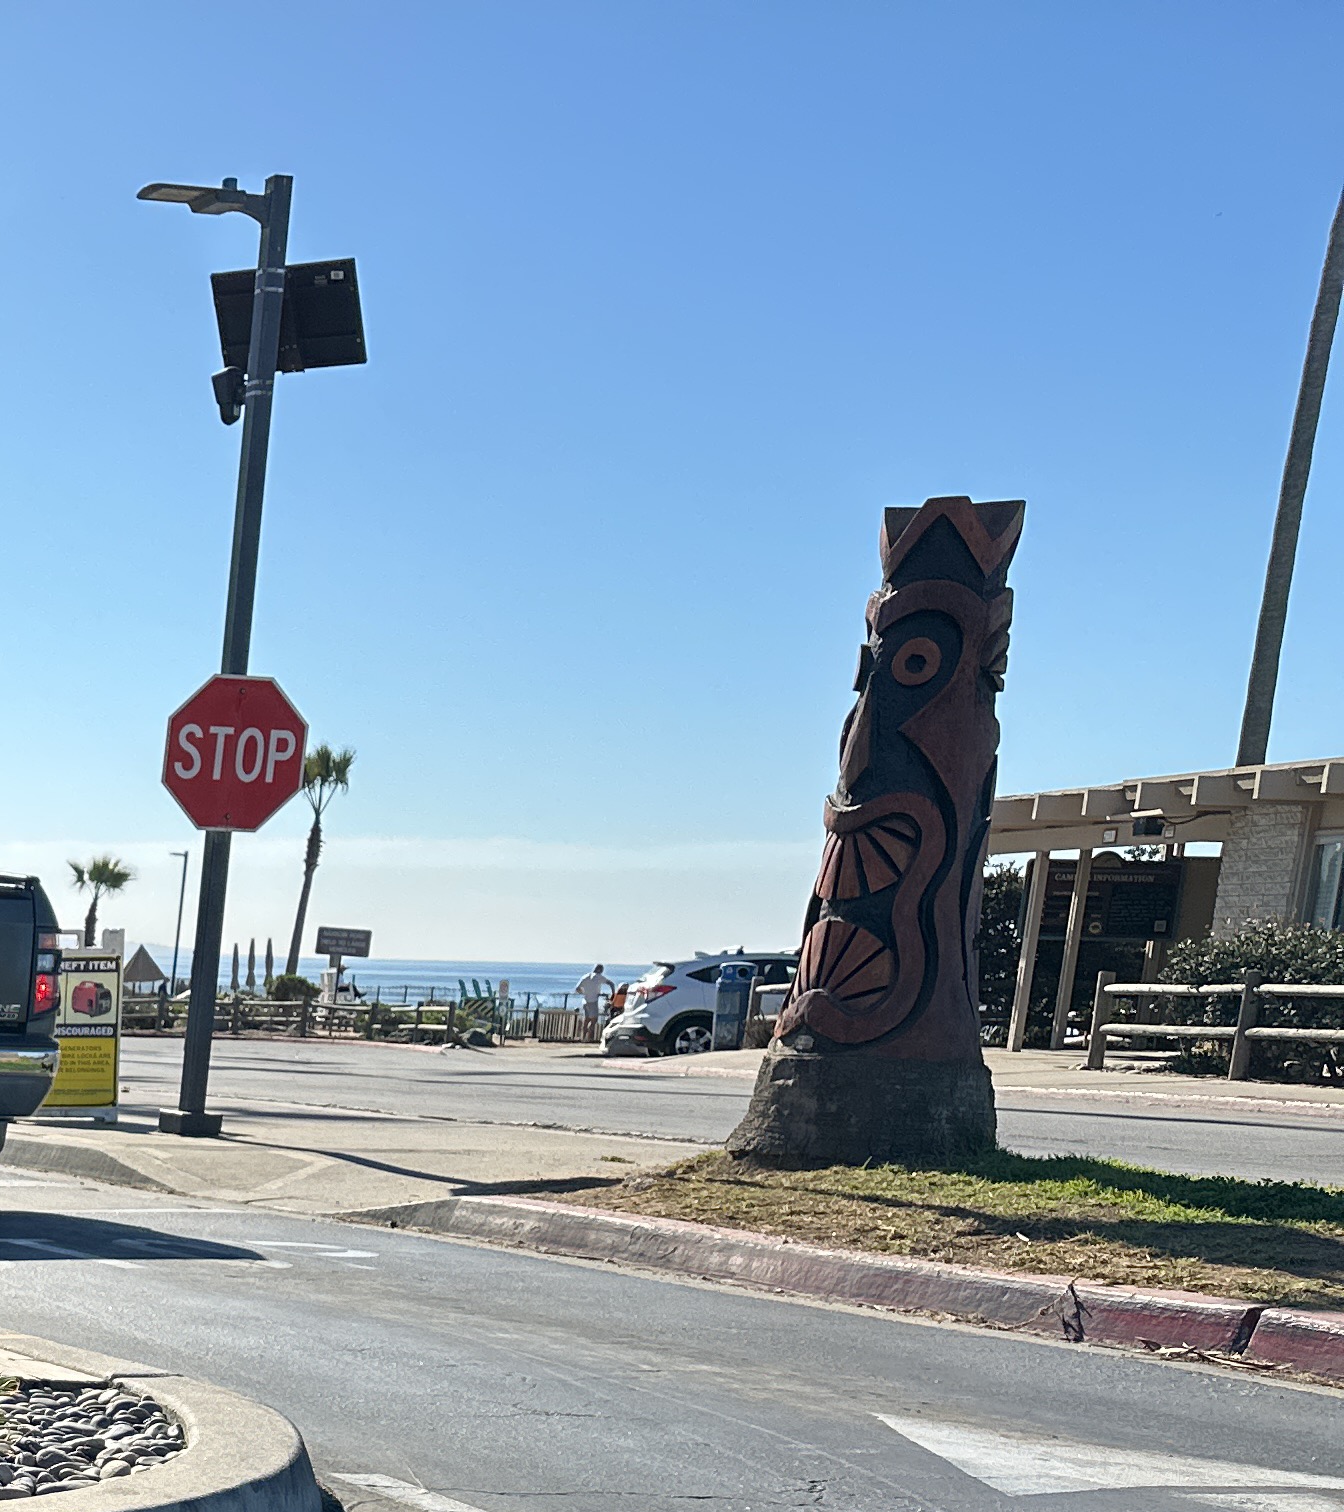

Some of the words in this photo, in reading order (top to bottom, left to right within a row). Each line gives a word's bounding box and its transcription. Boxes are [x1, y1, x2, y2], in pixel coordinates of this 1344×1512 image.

[172, 722, 297, 784] STOP
[1093, 874, 1155, 882] INFORMATION
[59, 960, 86, 971] HEFT
[89, 960, 116, 970] ITEM
